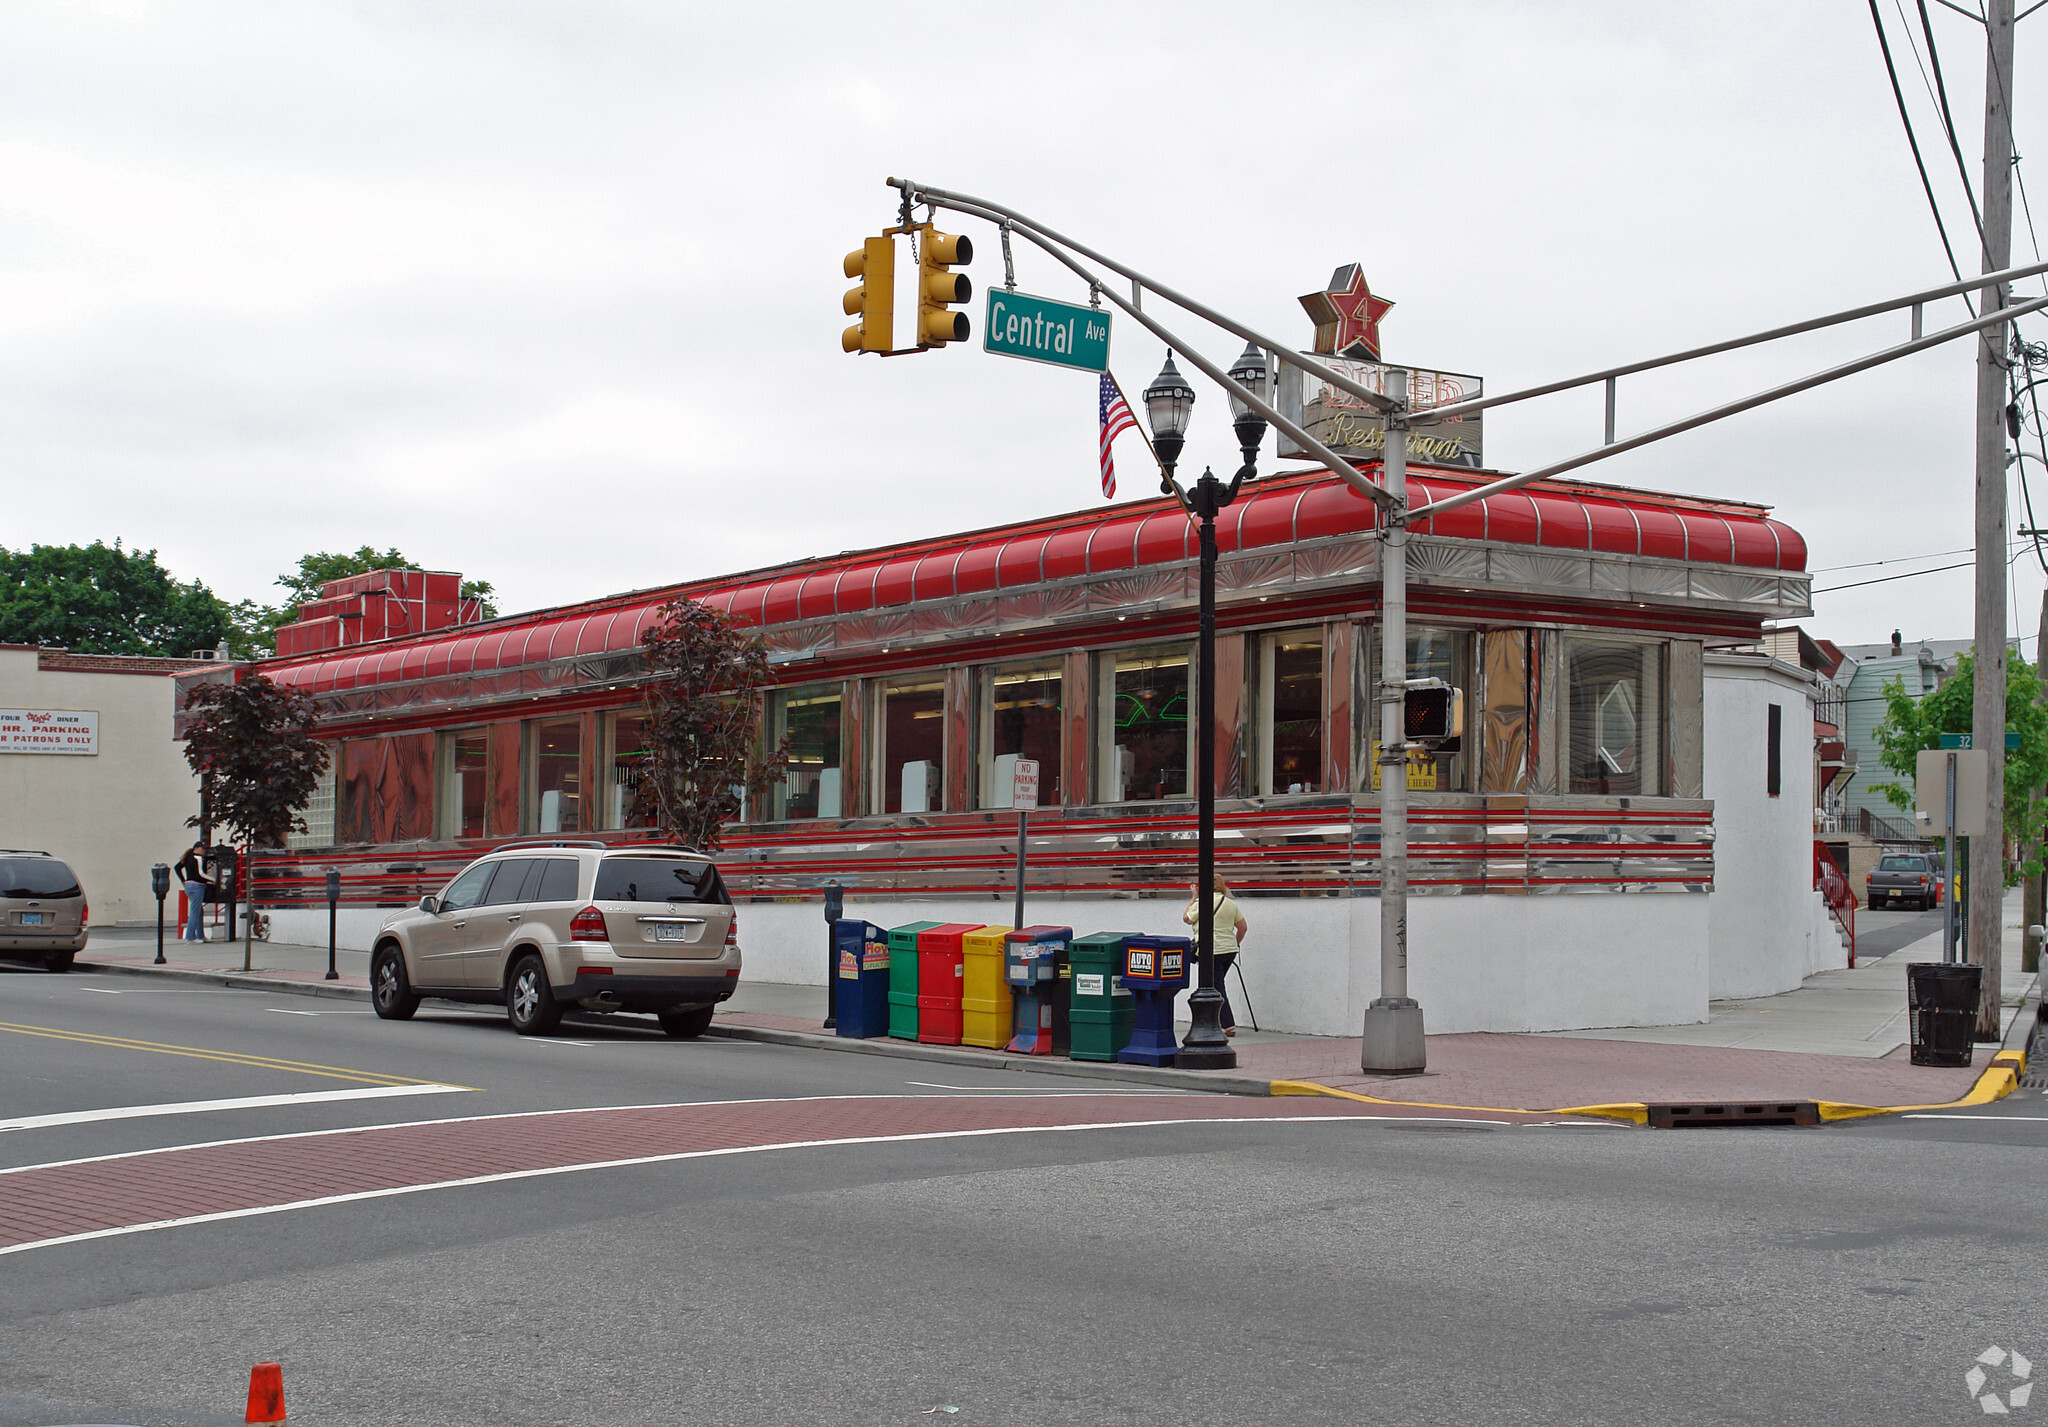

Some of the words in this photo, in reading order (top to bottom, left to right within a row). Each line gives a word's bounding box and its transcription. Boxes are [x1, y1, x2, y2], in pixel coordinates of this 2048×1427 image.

[1351, 297, 1372, 330] 4
[991, 301, 1075, 355] Central
[1085, 320, 1106, 342] Ave
[32, 726, 90, 734] PARKING
[13, 735, 61, 743] PATRONS
[1959, 735, 1971, 748] 32
[1021, 763, 1031, 773] NO
[1015, 774, 1037, 785] PARKING
[865, 942, 889, 955] Hoy
[841, 950, 857, 965] Hoy
[1130, 952, 1152, 965] AUTO
[1162, 954, 1181, 966] AUTO
